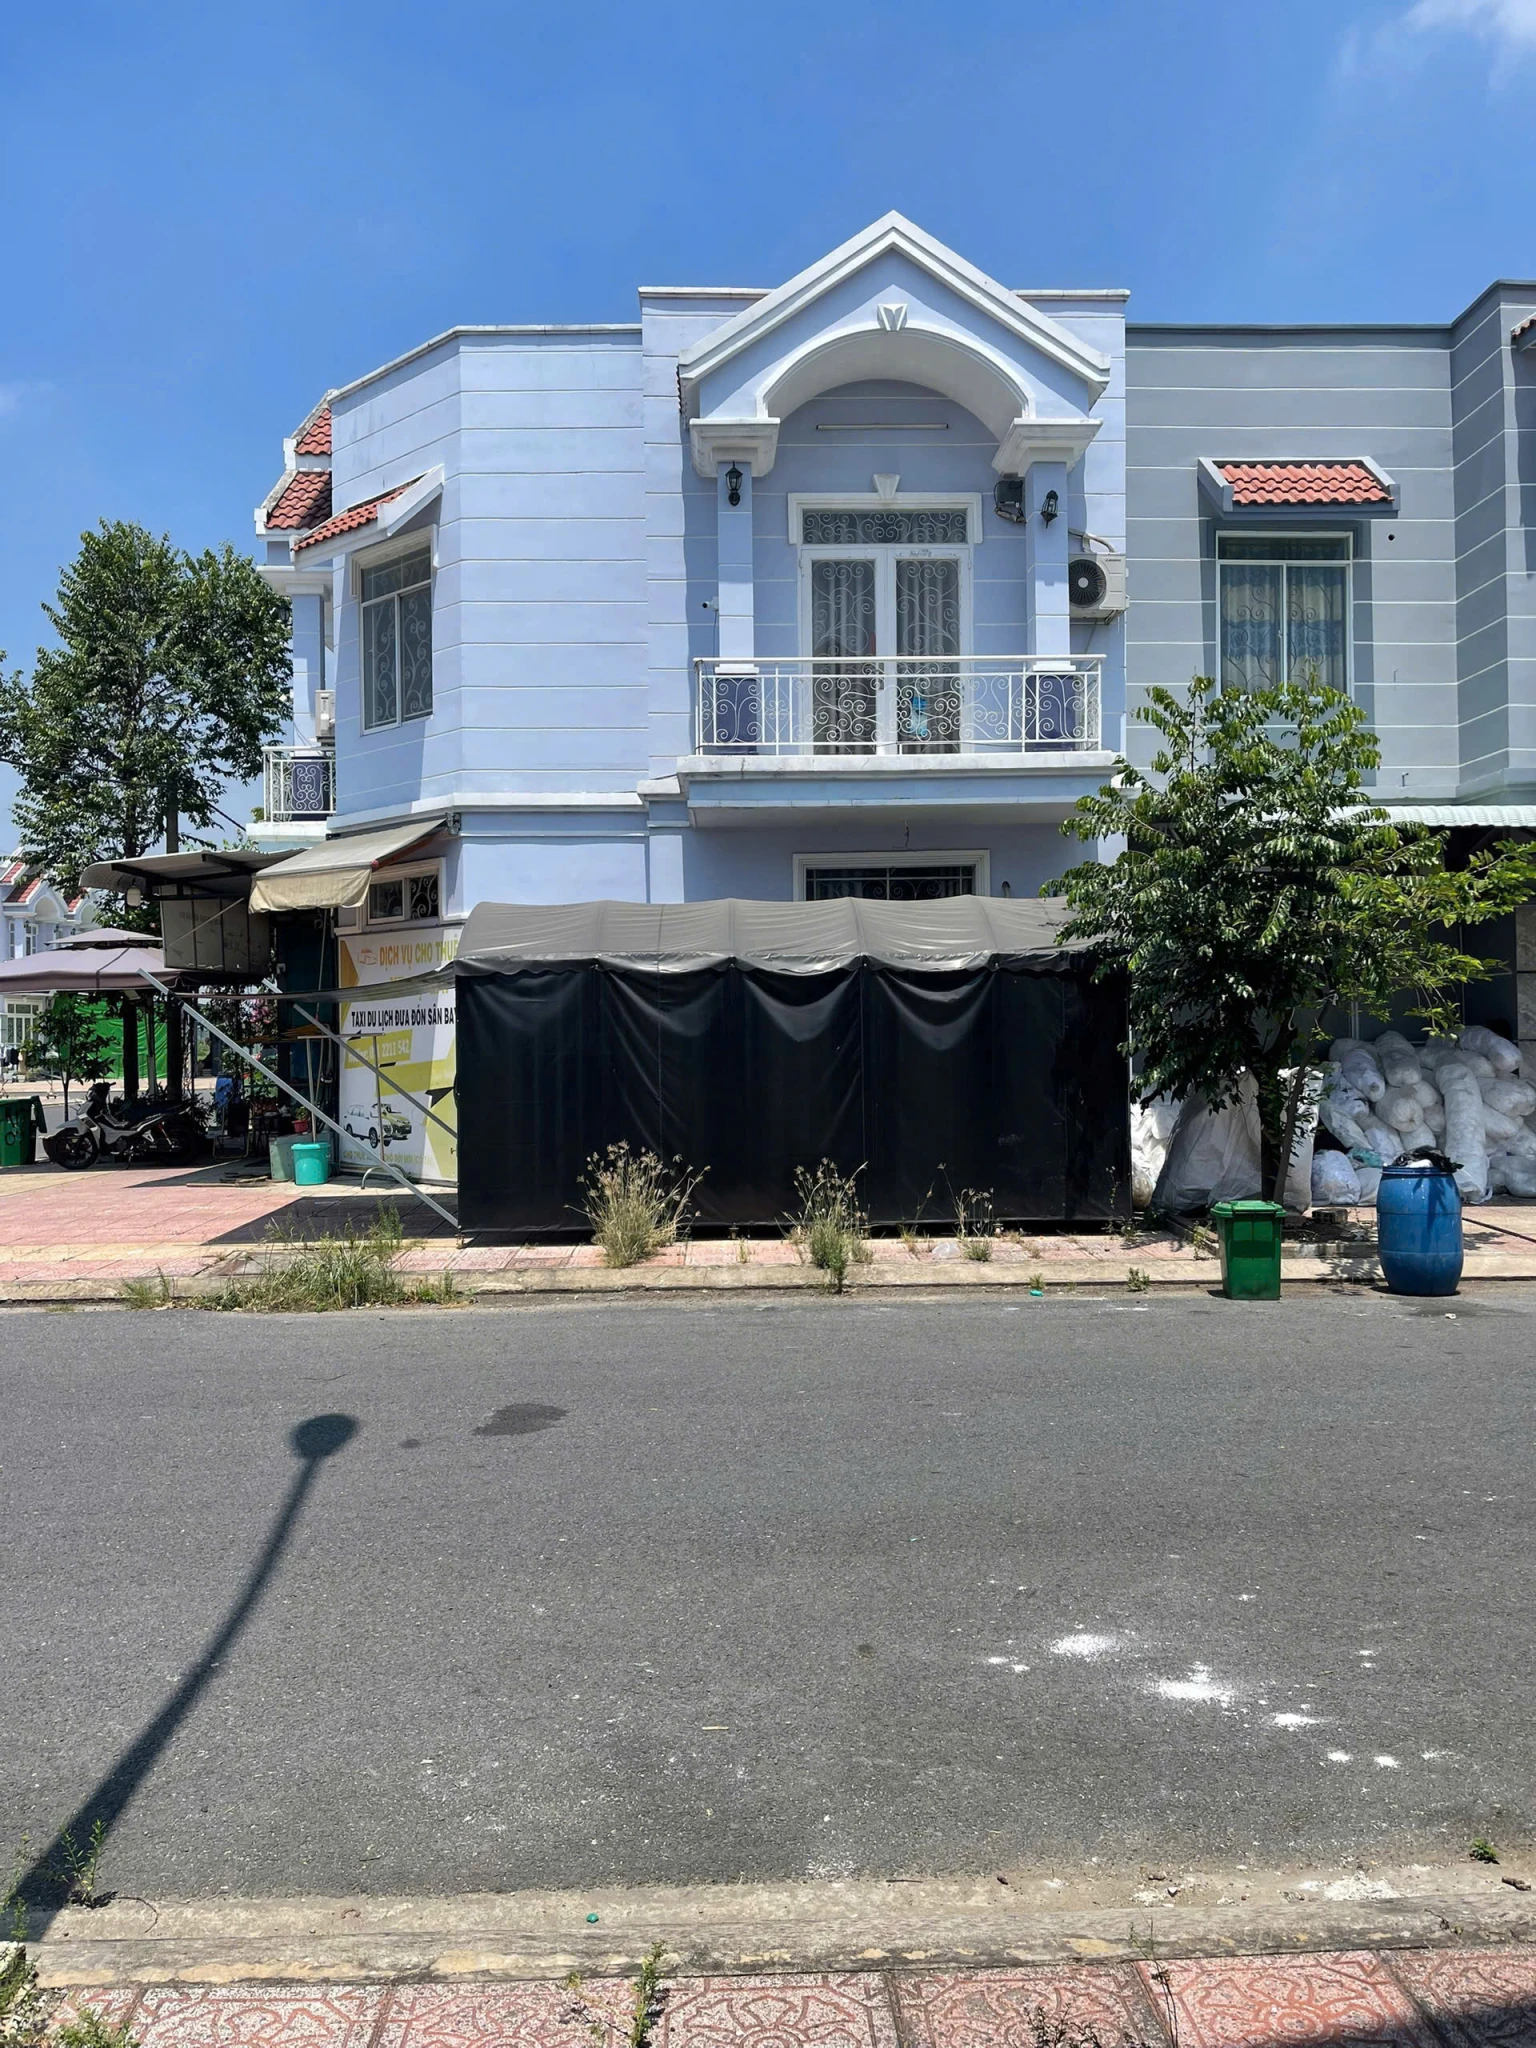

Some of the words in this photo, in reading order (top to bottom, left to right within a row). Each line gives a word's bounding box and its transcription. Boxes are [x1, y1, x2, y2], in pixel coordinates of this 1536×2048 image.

[379, 945, 399, 972] DỊCH
[401, 944, 413, 970] VỤ
[415, 942, 433, 964] CHO
[351, 1011, 366, 1028] TAXI
[367, 1010, 377, 1027] DU
[378, 1008, 394, 1031] LỊCH
[395, 1008, 410, 1026] ĐƯA
[411, 1004, 426, 1025] ĐÓN
[427, 1003, 443, 1025] SÂN
[381, 1042, 397, 1057] 2211
[398, 1039, 410, 1054] 542
